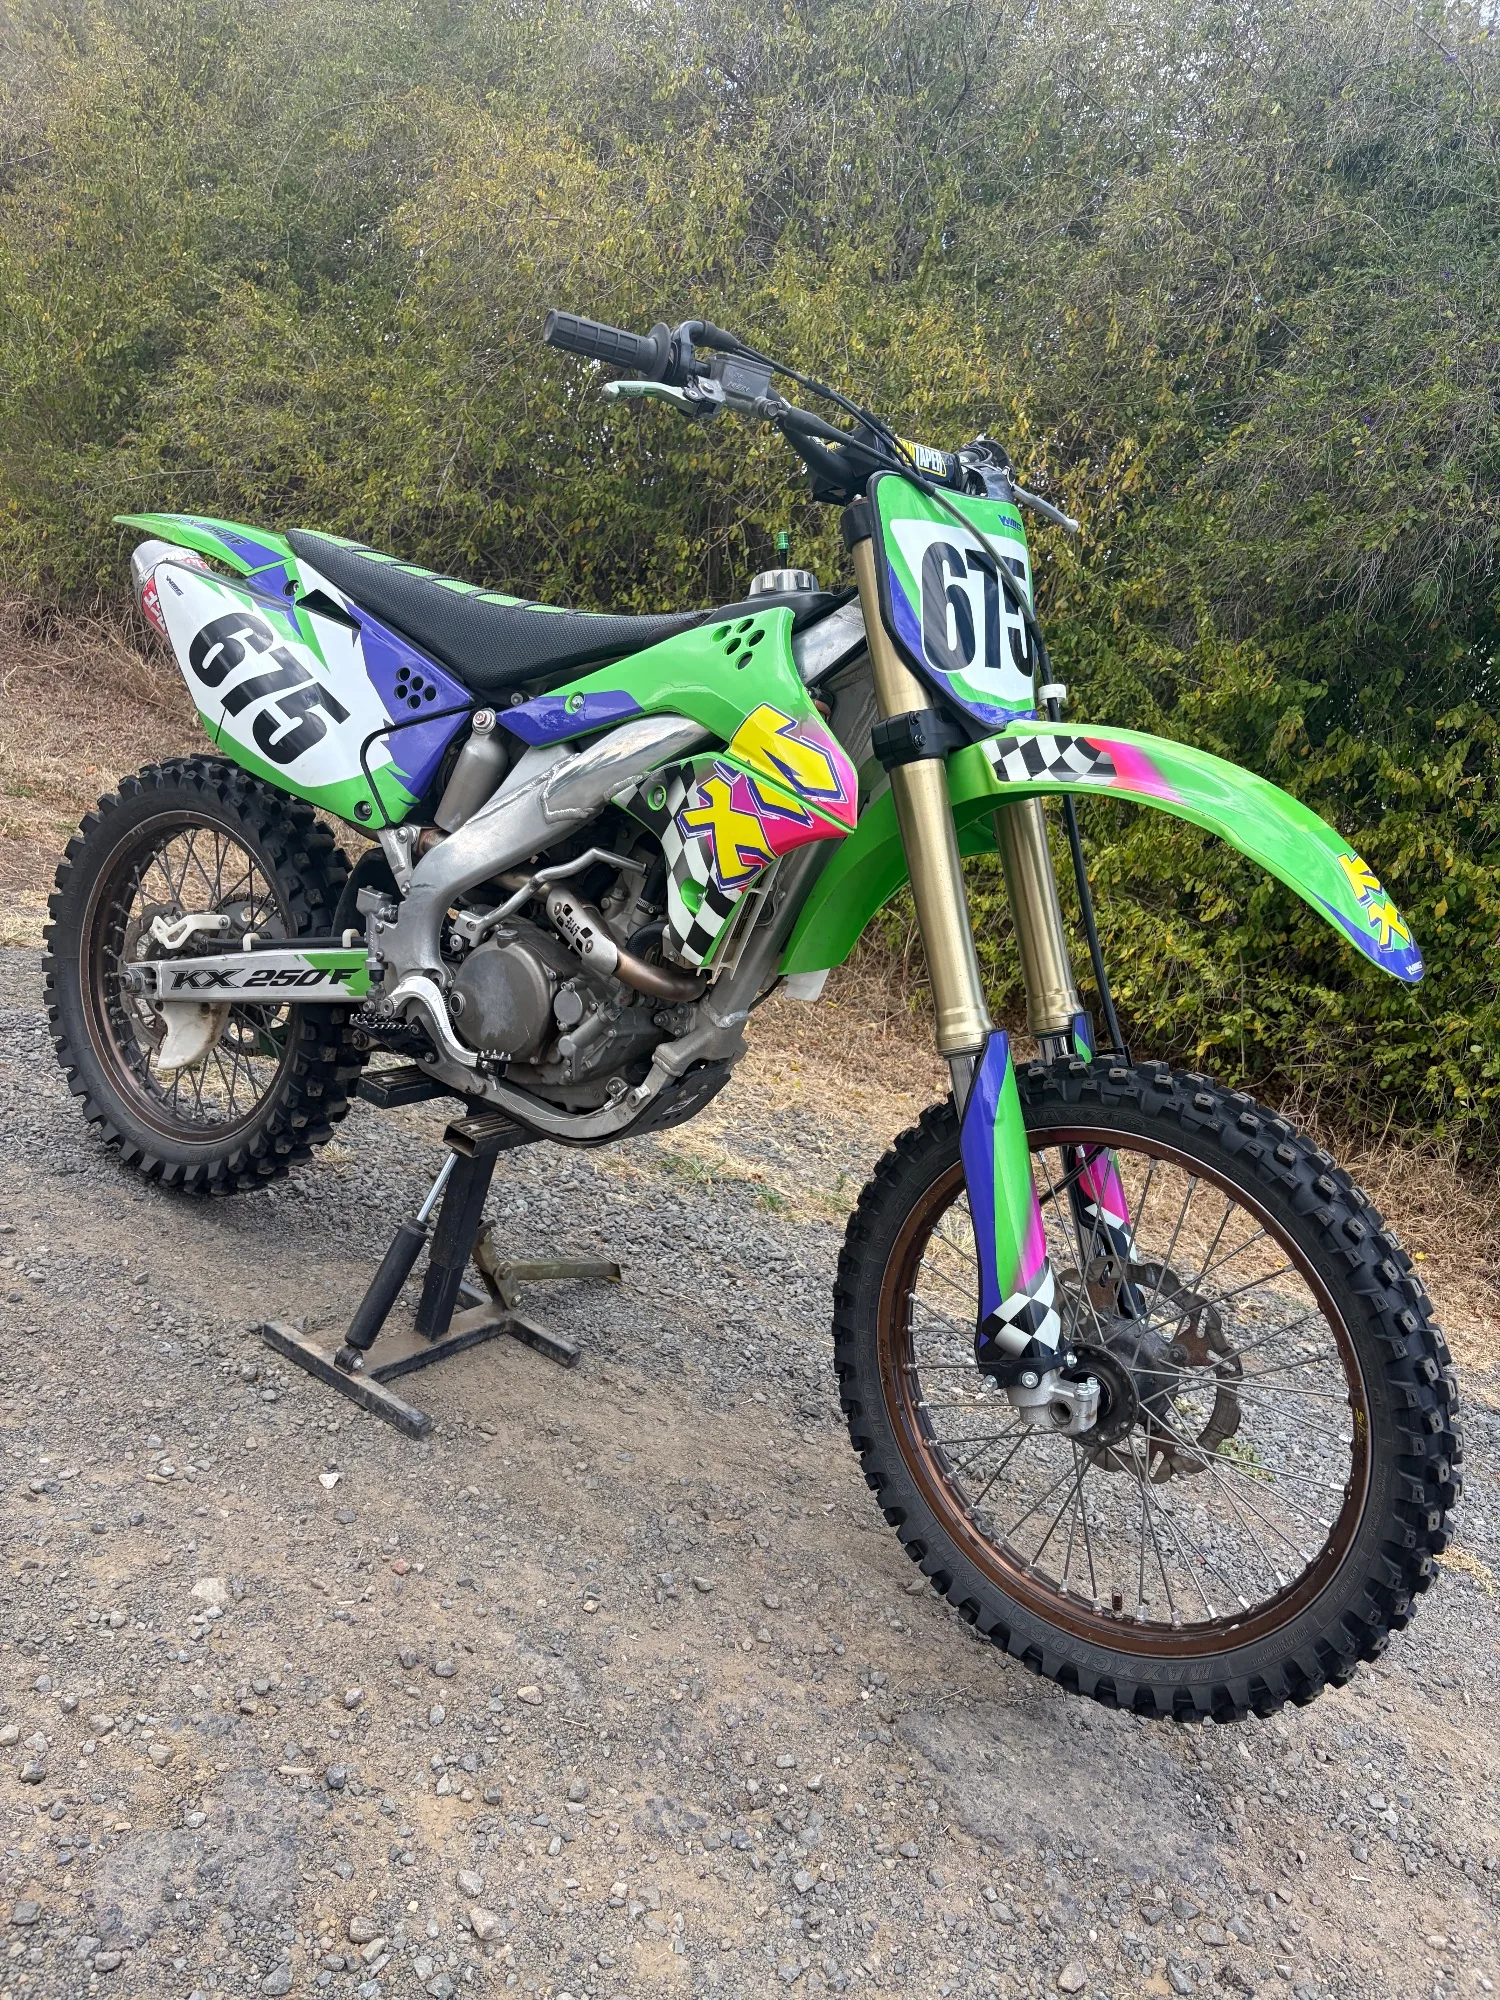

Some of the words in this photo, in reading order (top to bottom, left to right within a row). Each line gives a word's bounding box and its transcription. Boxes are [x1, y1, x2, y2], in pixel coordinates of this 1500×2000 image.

[921, 541, 1033, 678] 675
[189, 612, 351, 765] 675
[677, 702, 848, 893] KX
[1337, 852, 1415, 952] KX
